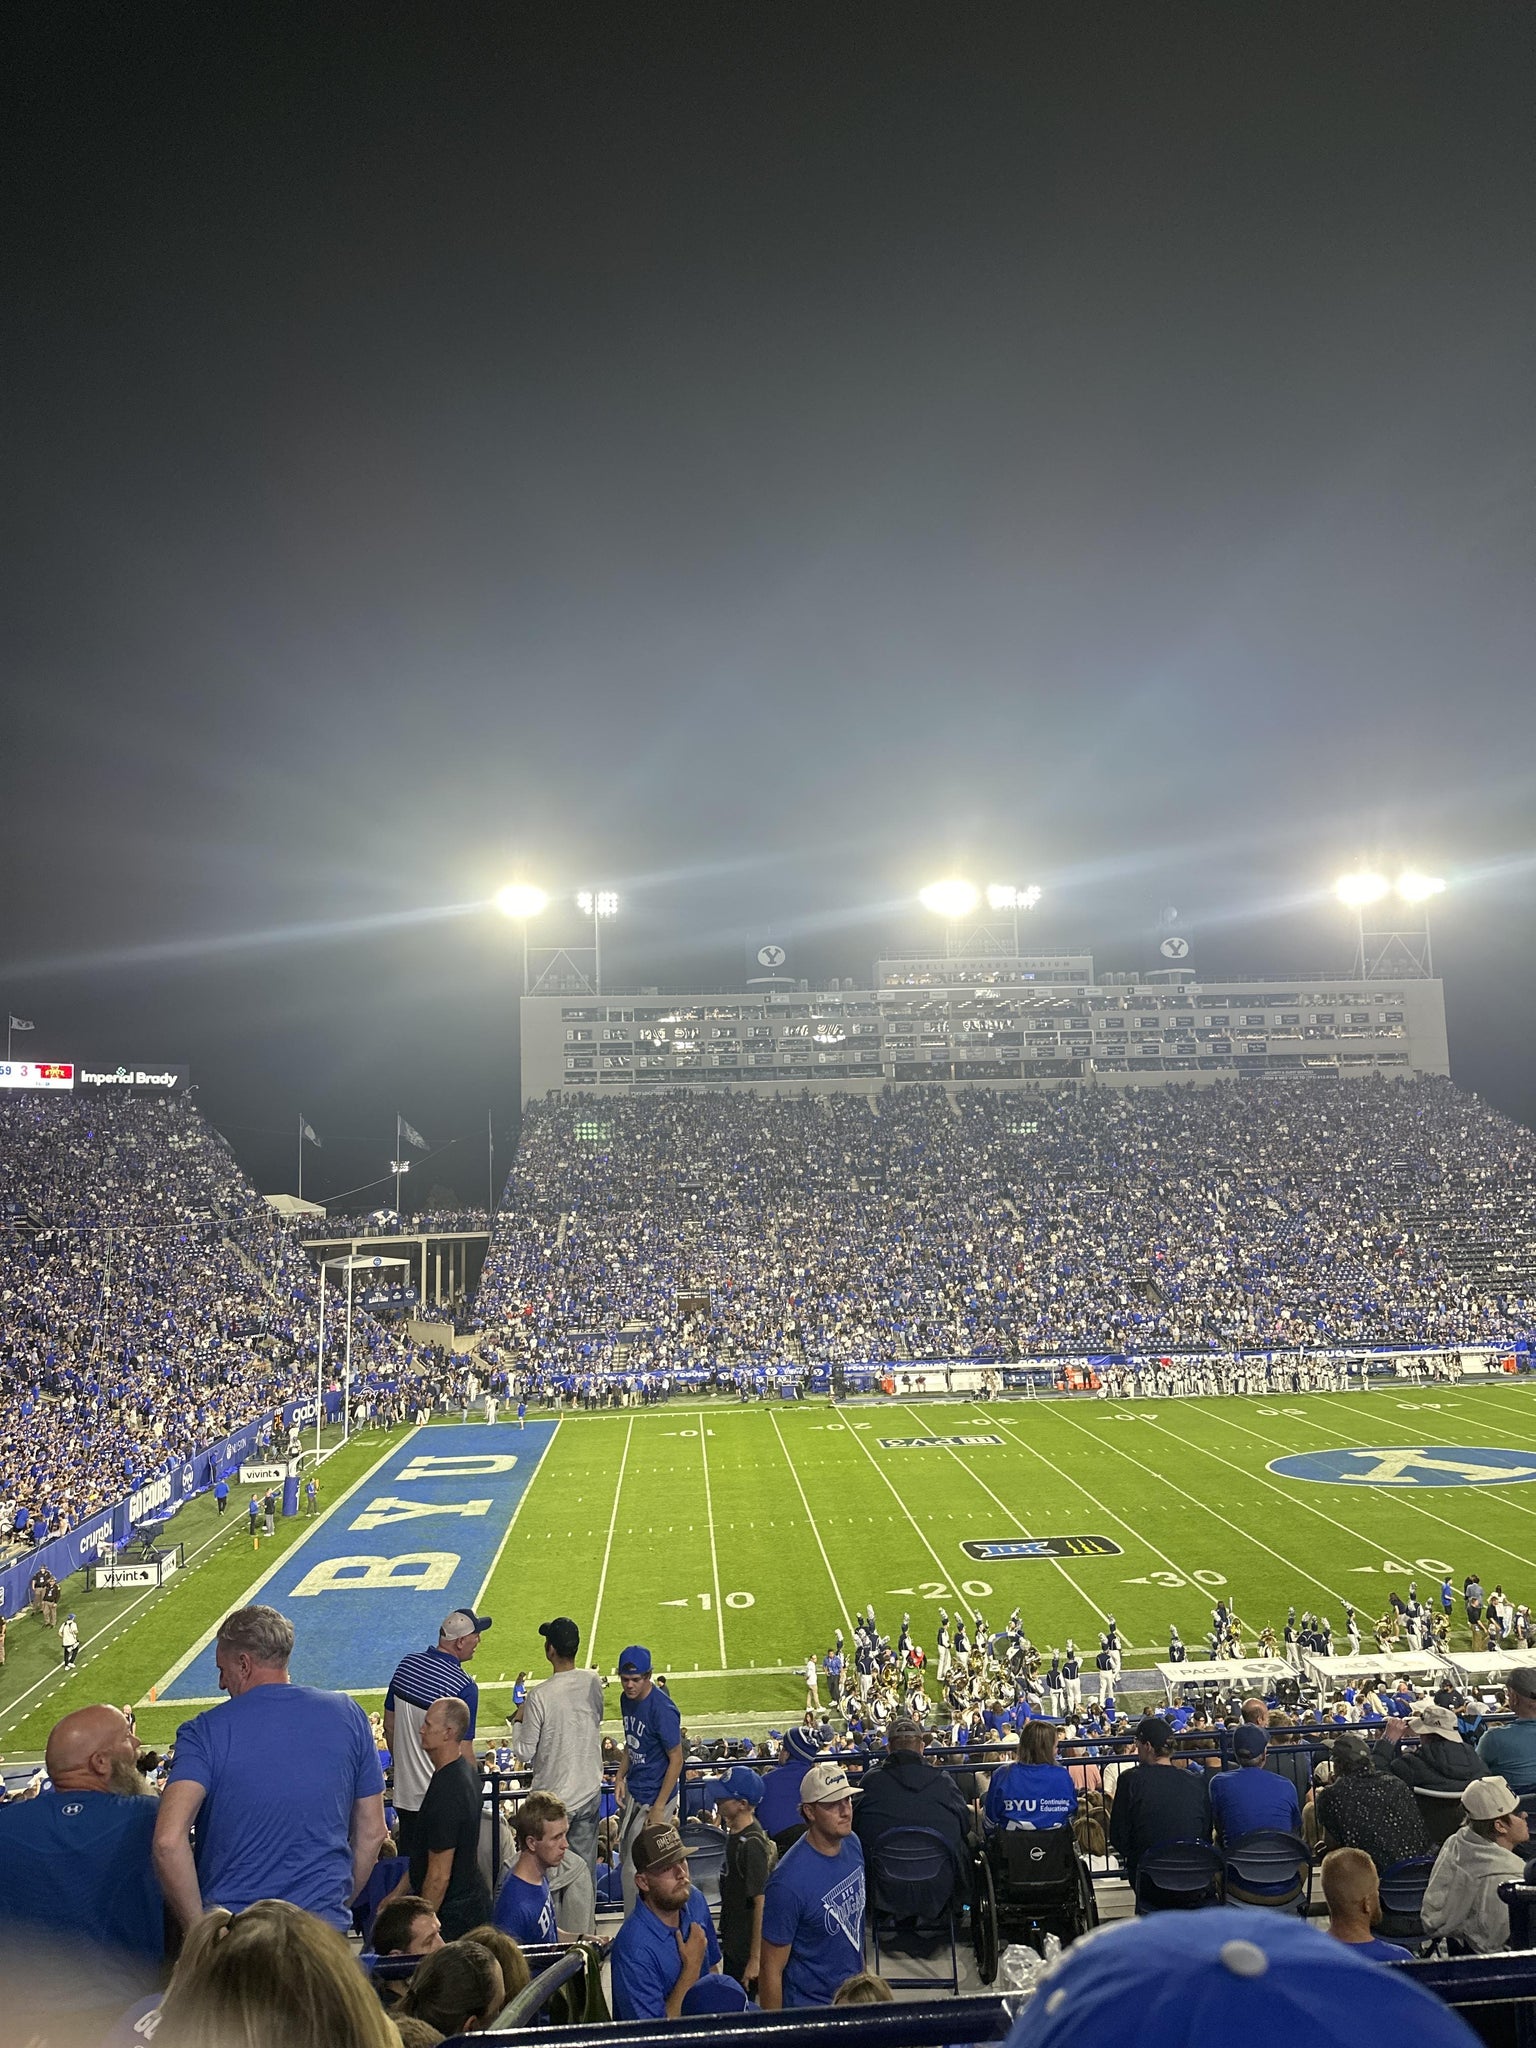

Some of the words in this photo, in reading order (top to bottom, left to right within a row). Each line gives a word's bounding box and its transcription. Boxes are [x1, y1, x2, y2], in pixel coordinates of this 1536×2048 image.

[20, 1065, 28, 1077] 3
[80, 1069, 134, 1086] Imperial
[135, 1071, 178, 1088] Brady
[128, 1491, 144, 1523] GO
[143, 1474, 172, 1516] COUGS
[288, 1454, 518, 1597] BYU
[1382, 1558, 1455, 1576] 40
[1149, 1568, 1228, 1588] 30
[918, 1579, 994, 1601] 20
[697, 1591, 757, 1611] 10
[623, 1715, 646, 1737] BYU
[1003, 1799, 1037, 1812] BYU
[841, 1885, 854, 1901] BYU
